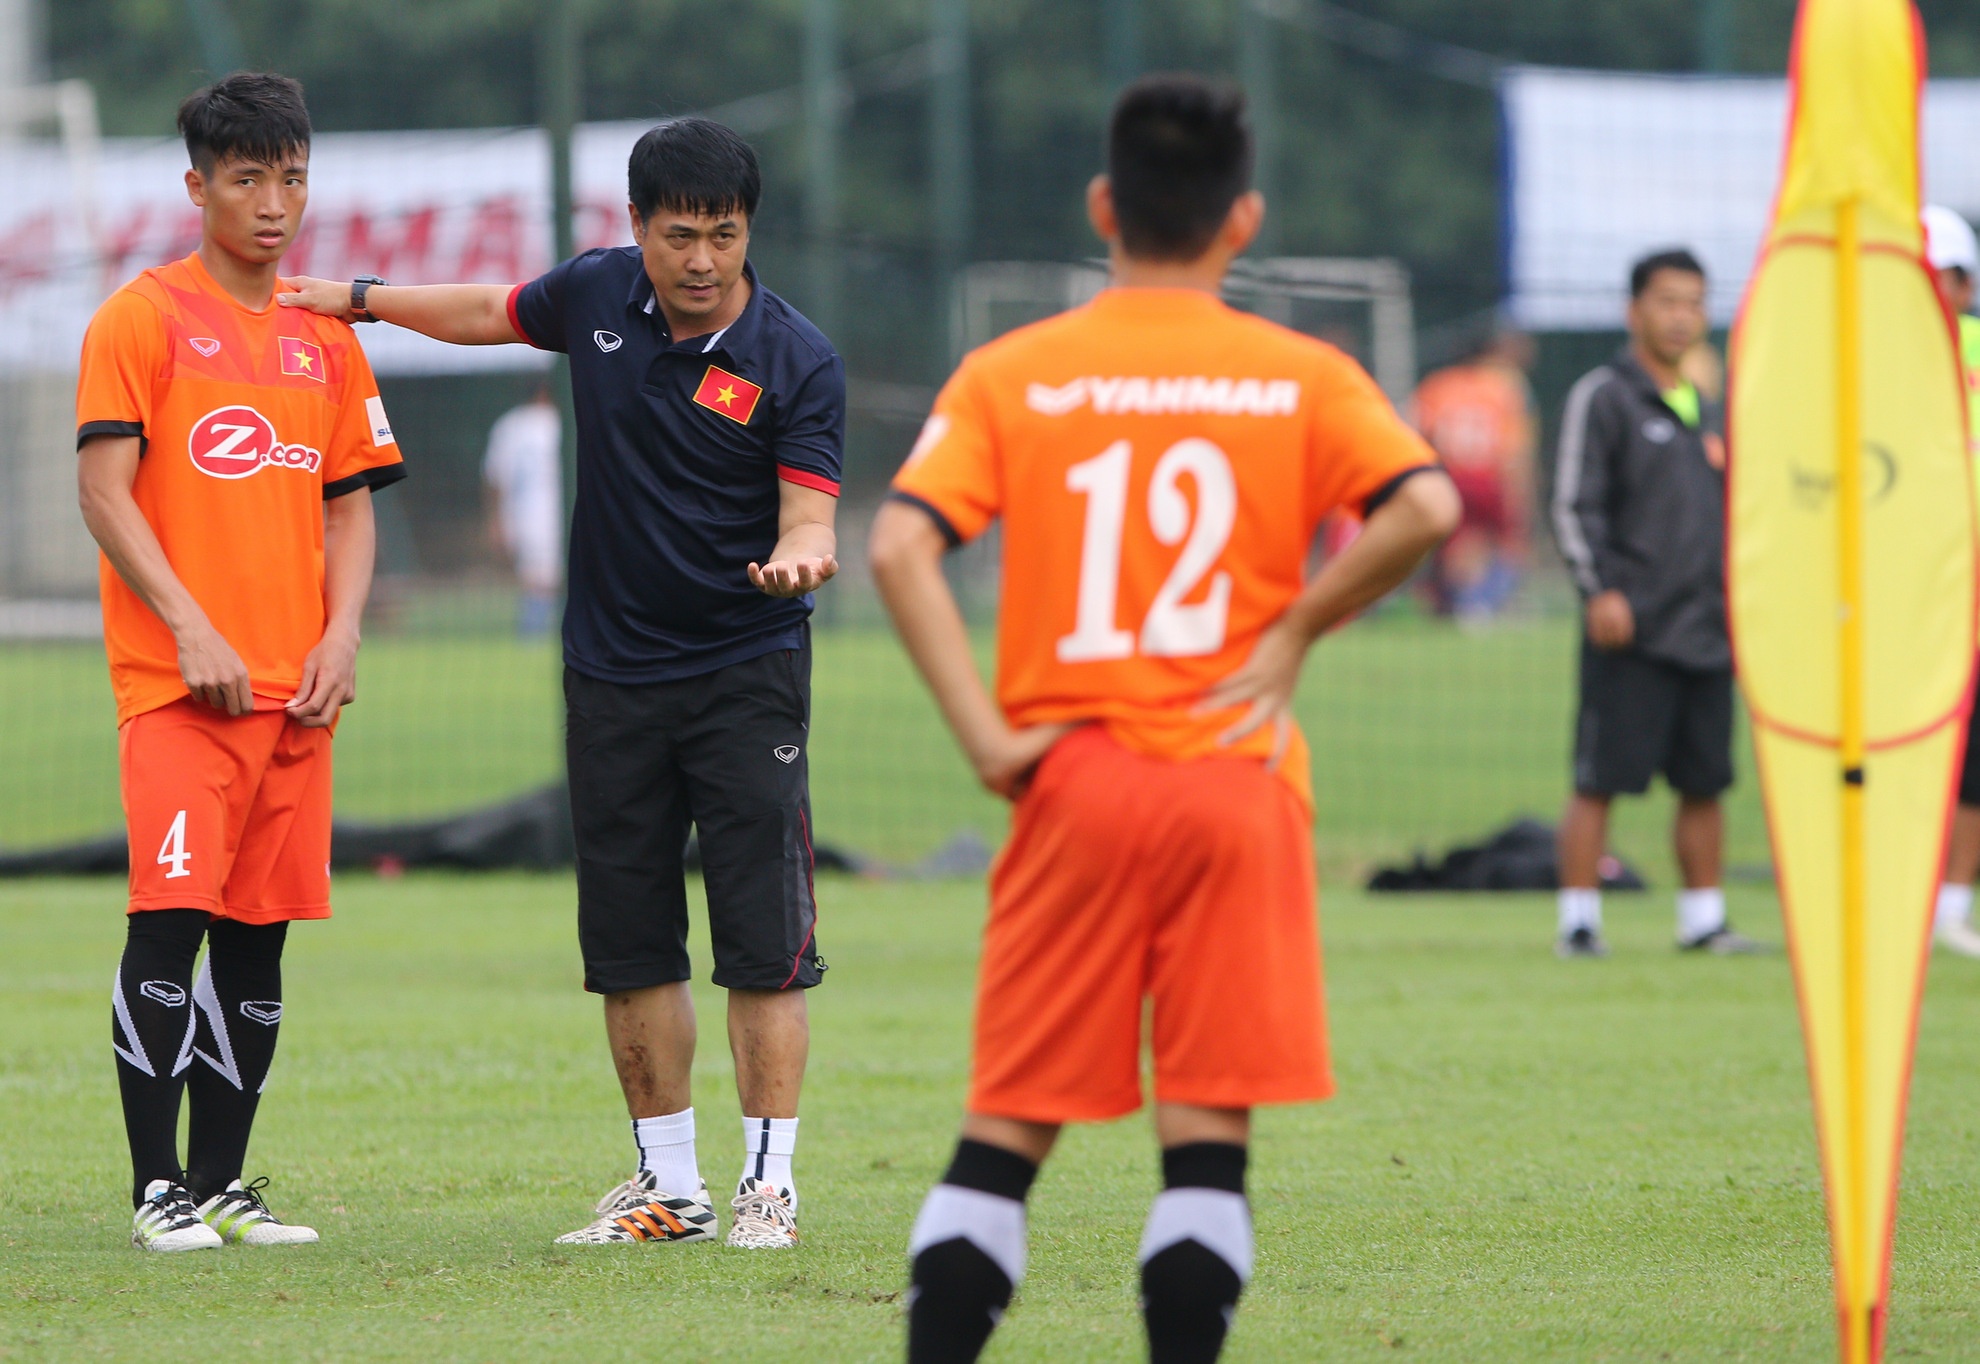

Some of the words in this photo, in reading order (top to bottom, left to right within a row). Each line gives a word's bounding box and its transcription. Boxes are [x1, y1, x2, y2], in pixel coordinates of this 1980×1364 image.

[1089, 376, 1299, 416] YANMAR
[1057, 437, 1238, 662] 12
[157, 809, 192, 879] 4
